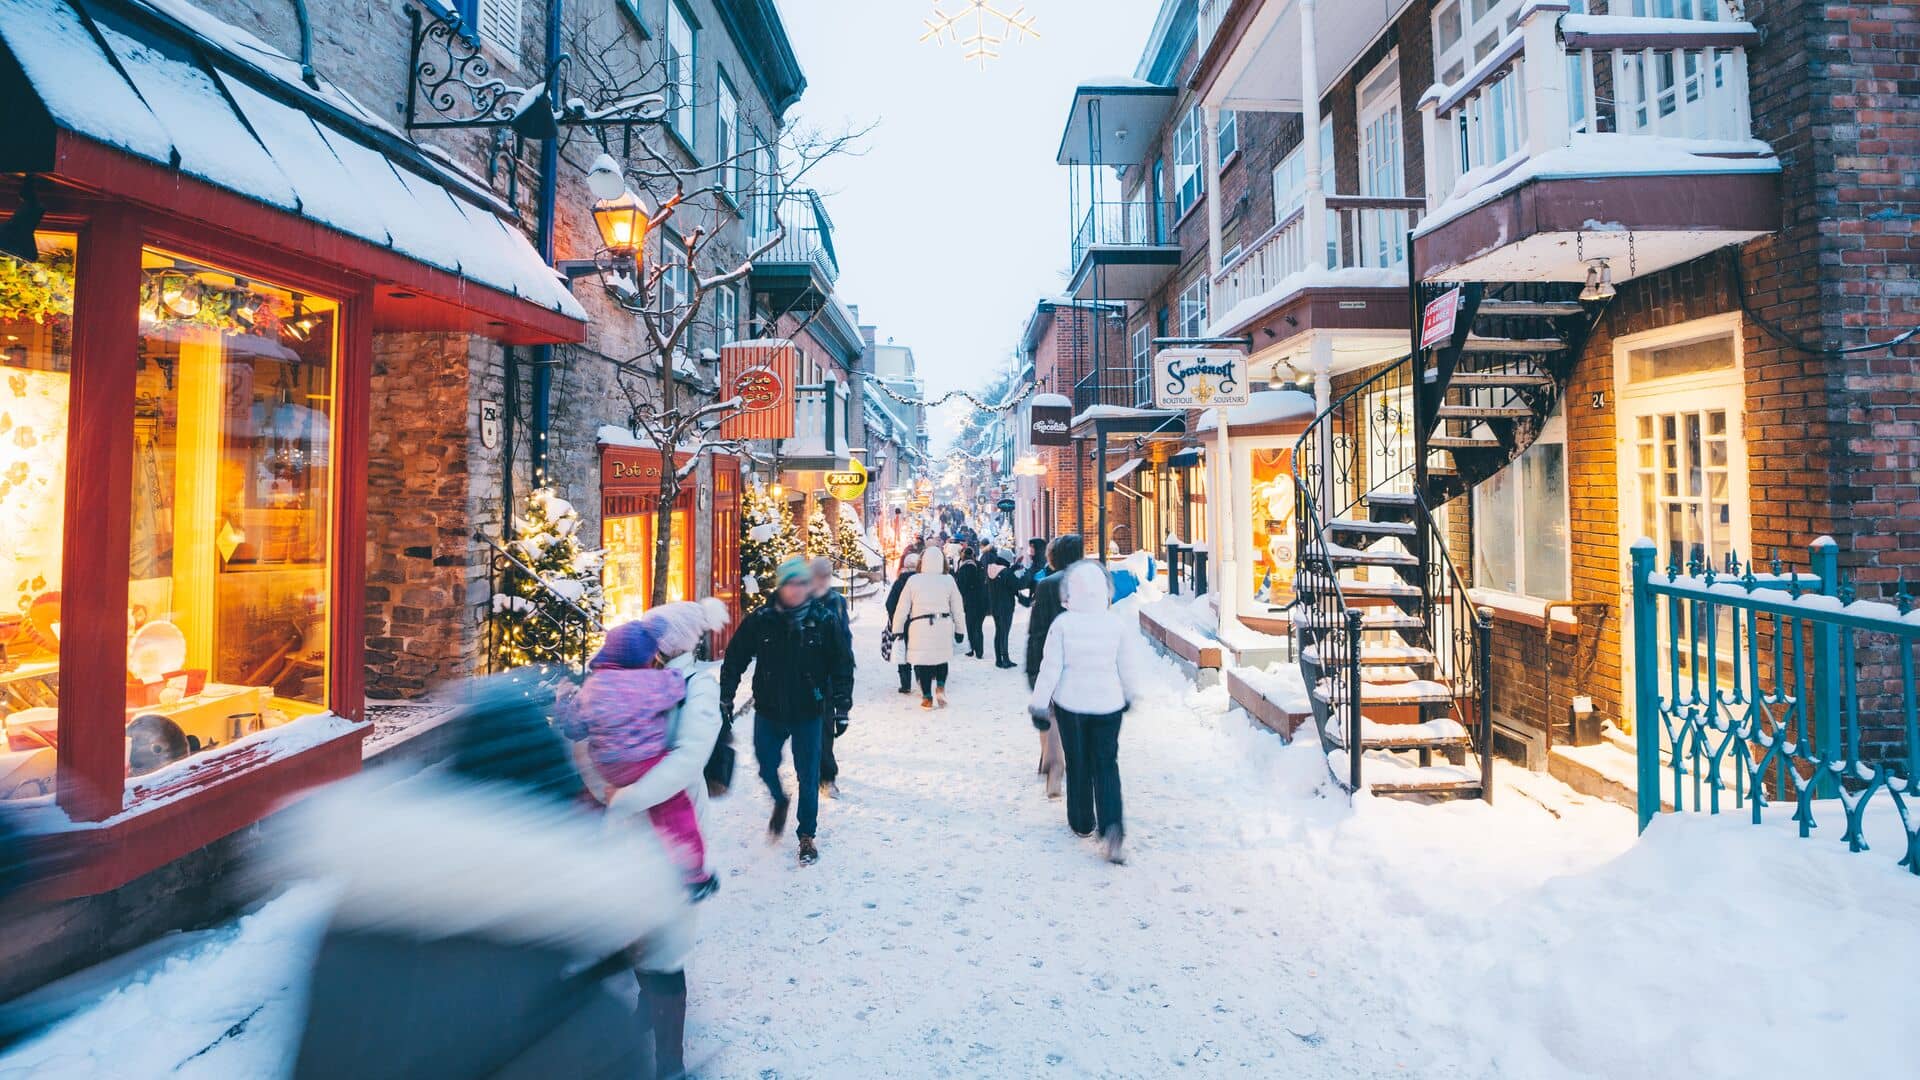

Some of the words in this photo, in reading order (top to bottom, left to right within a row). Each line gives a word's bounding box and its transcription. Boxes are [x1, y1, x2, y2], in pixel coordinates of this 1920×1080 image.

[1593, 393, 1604, 408] 24
[612, 460, 642, 478] Pot
[831, 474, 860, 485] ZAZOU
